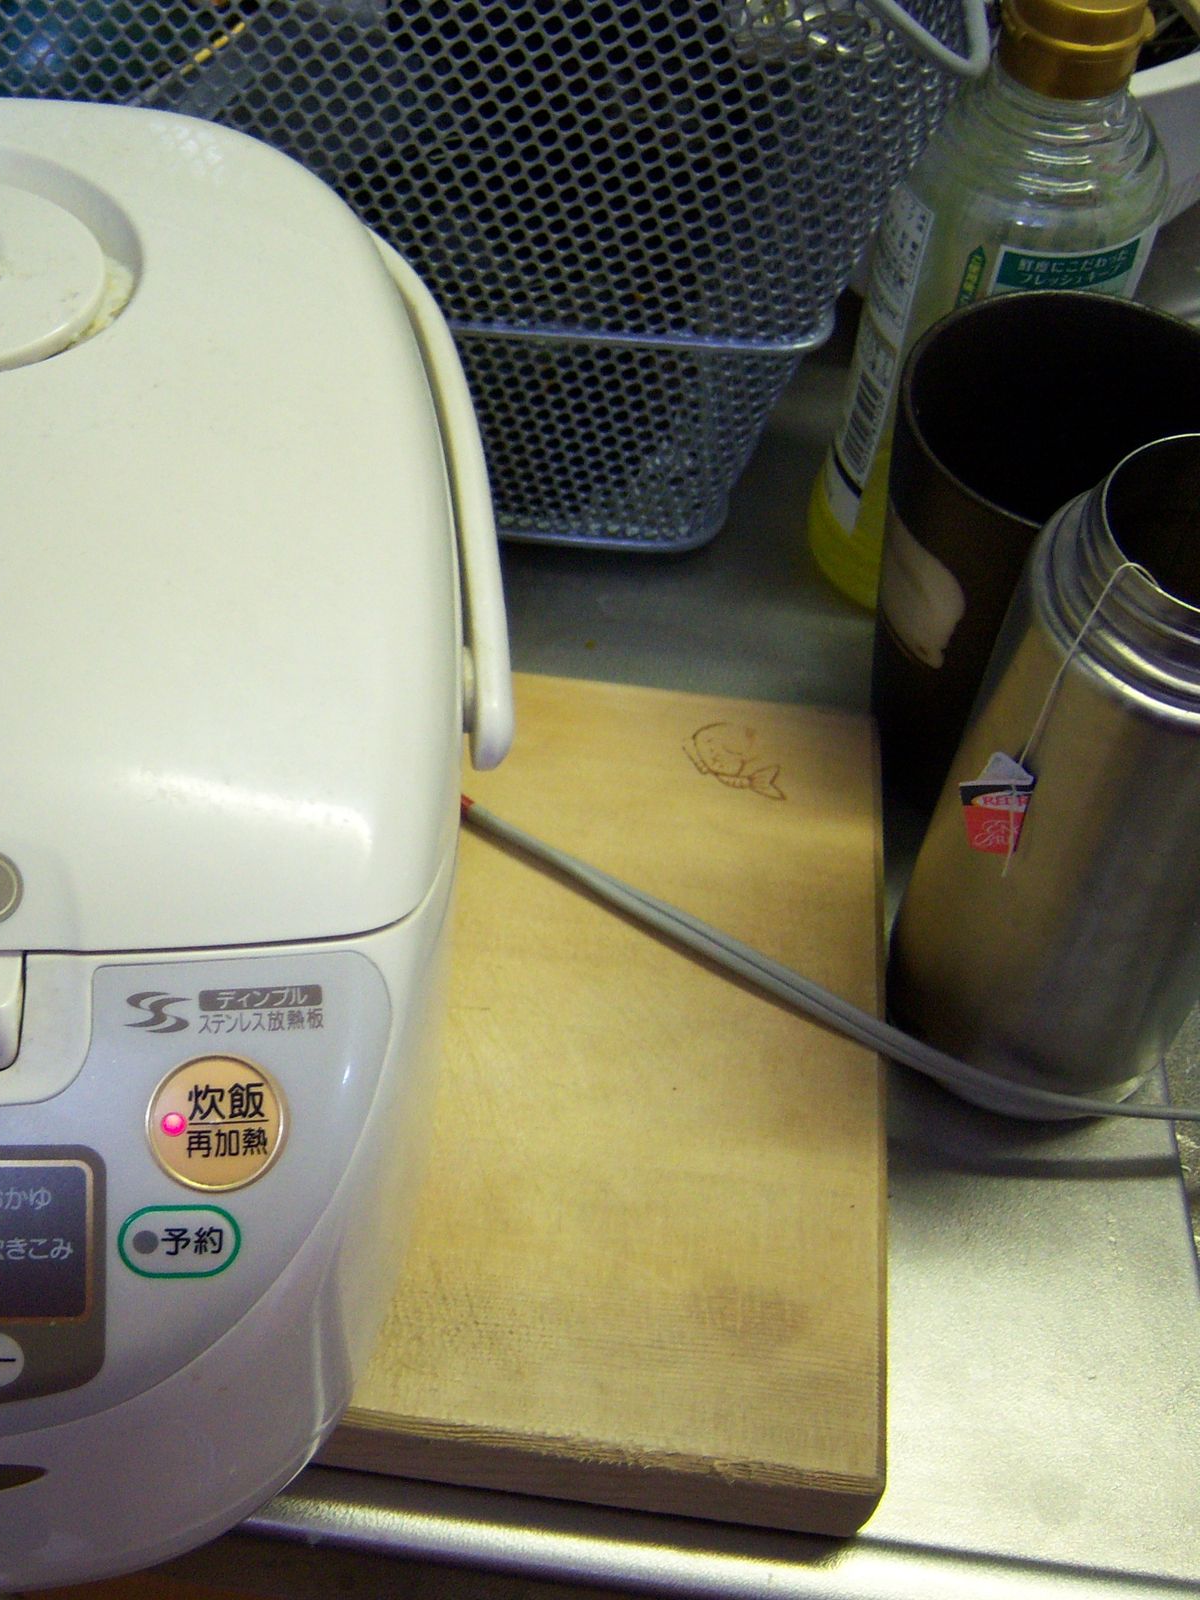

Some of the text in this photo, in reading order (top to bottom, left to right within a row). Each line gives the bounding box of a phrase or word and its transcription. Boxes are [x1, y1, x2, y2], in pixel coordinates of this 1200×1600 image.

[198, 1008, 325, 1034] ステンレス放熱板
[187, 1082, 265, 1121] 炊飯
[187, 1129, 268, 1158] 再加熱
[161, 1226, 224, 1256] 予約
